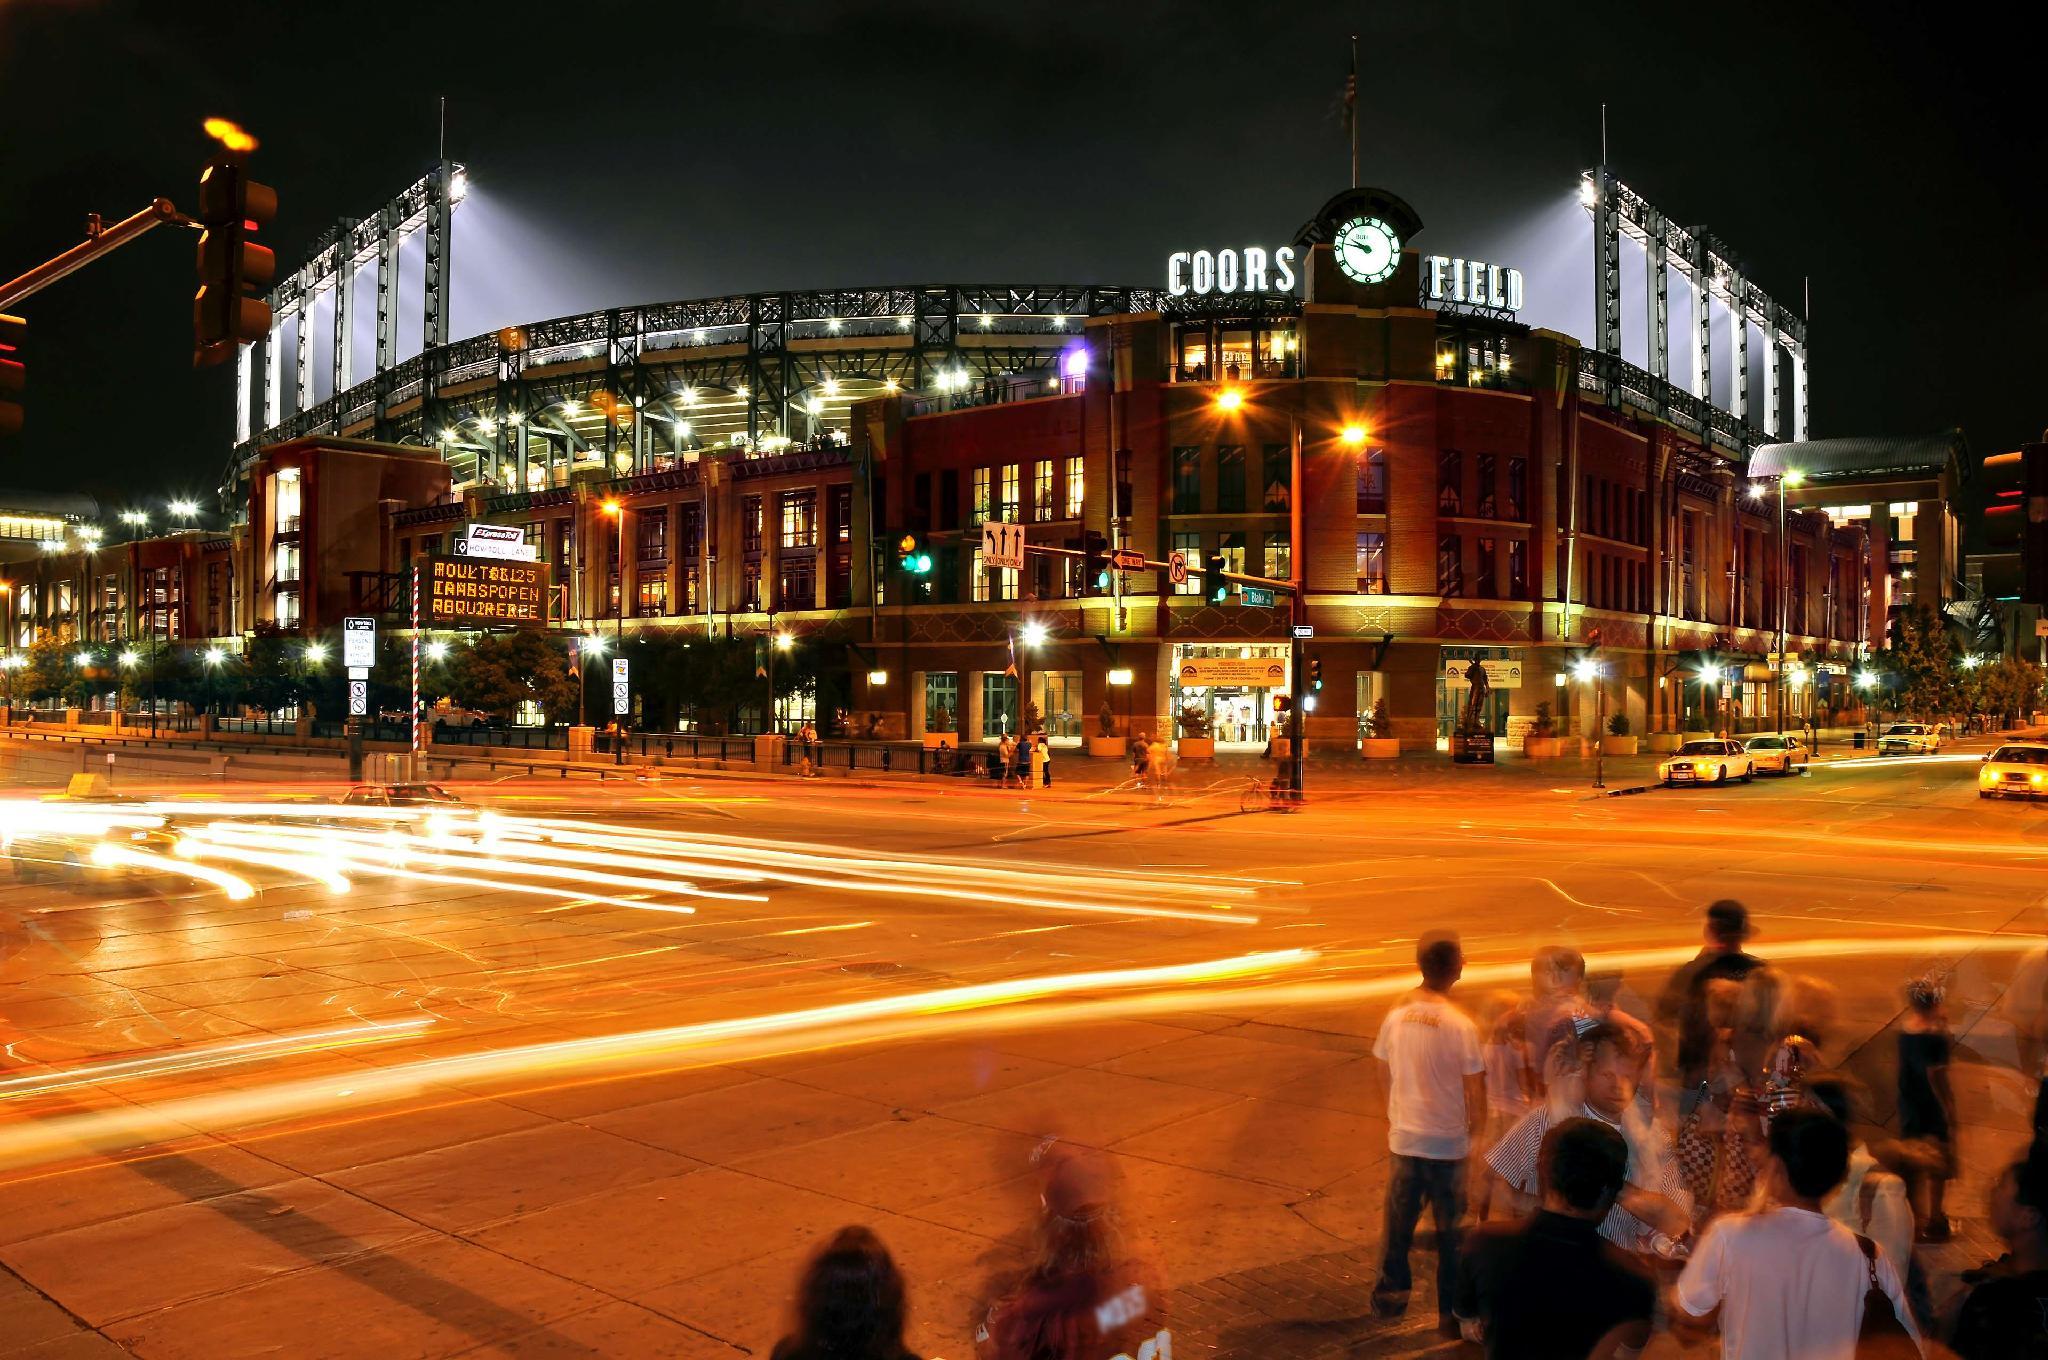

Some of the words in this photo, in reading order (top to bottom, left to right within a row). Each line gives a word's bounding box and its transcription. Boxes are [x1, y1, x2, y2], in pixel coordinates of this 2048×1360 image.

[1168, 246, 1295, 296] COORS
[1428, 255, 1523, 312] FIELD
[1251, 591, 1265, 604] Blake
